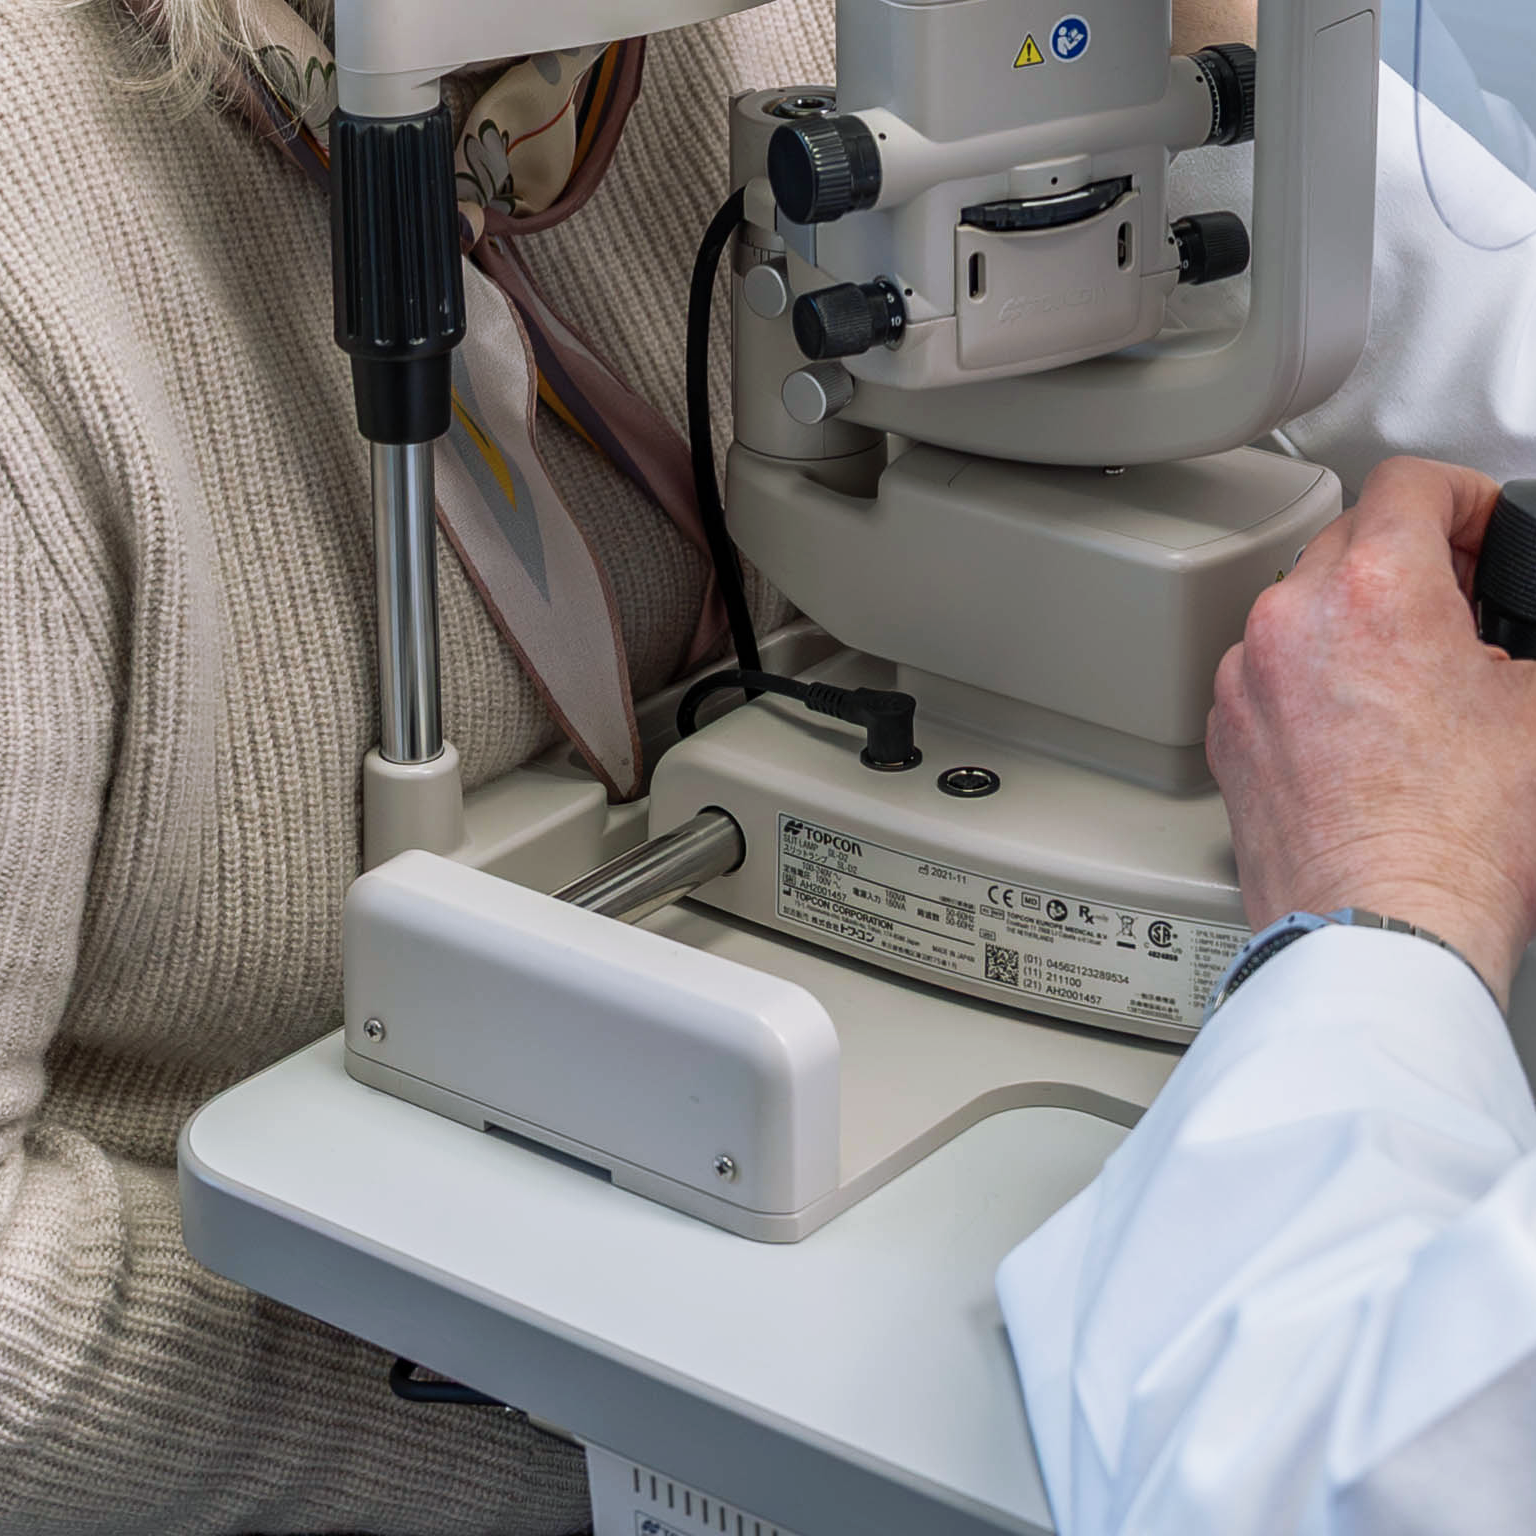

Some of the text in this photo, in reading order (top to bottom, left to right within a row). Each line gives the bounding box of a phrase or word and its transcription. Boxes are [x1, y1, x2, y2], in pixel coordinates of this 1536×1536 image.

[886, 292, 895, 303] 5
[890, 316, 902, 327] 10
[804, 826, 863, 858] TOPCON
[931, 866, 968, 884] 2021-11
[799, 879, 847, 901] AH2001457
[794, 890, 830, 910] TOPCON
[832, 903, 894, 931] CORPORATION
[1024, 896, 1037, 906] MD
[1023, 953, 1043, 967] (01)
[1023, 966, 1082, 988] (11) 211100
[1023, 978, 1103, 1006] (21) AH2001457
